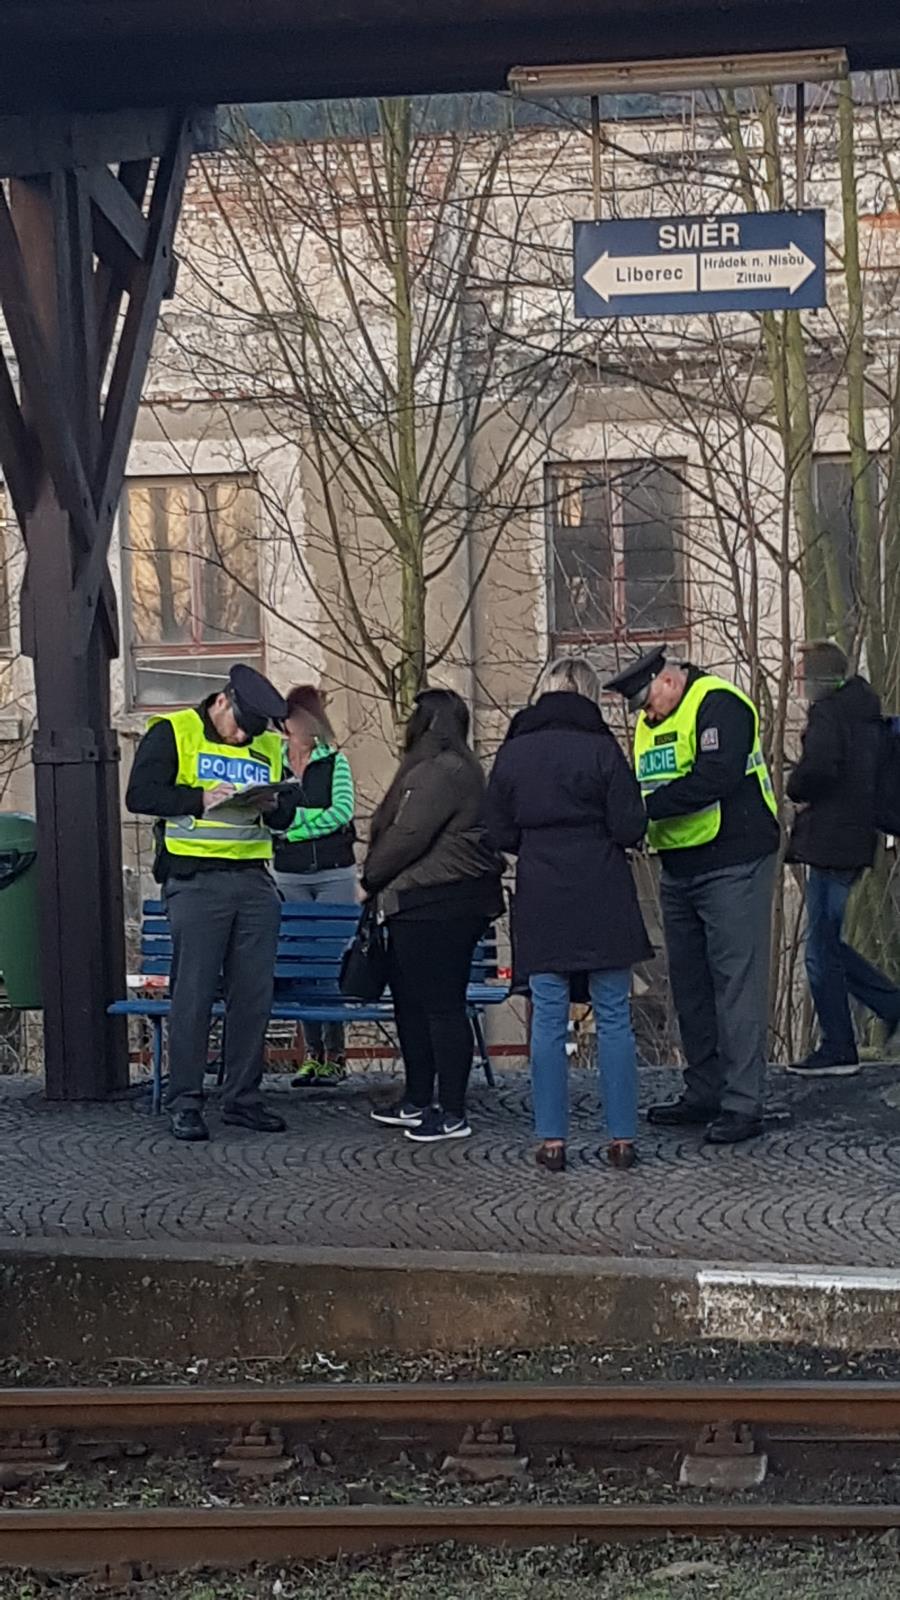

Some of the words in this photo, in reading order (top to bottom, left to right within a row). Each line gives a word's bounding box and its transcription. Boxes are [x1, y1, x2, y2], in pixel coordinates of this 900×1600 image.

[658, 217, 740, 249] SMĚR
[704, 256, 747, 269] Hrádek
[752, 257, 763, 267] n.
[616, 266, 683, 282] Liberec
[736, 272, 771, 284] Zittau
[201, 758, 268, 784] POLICIE
